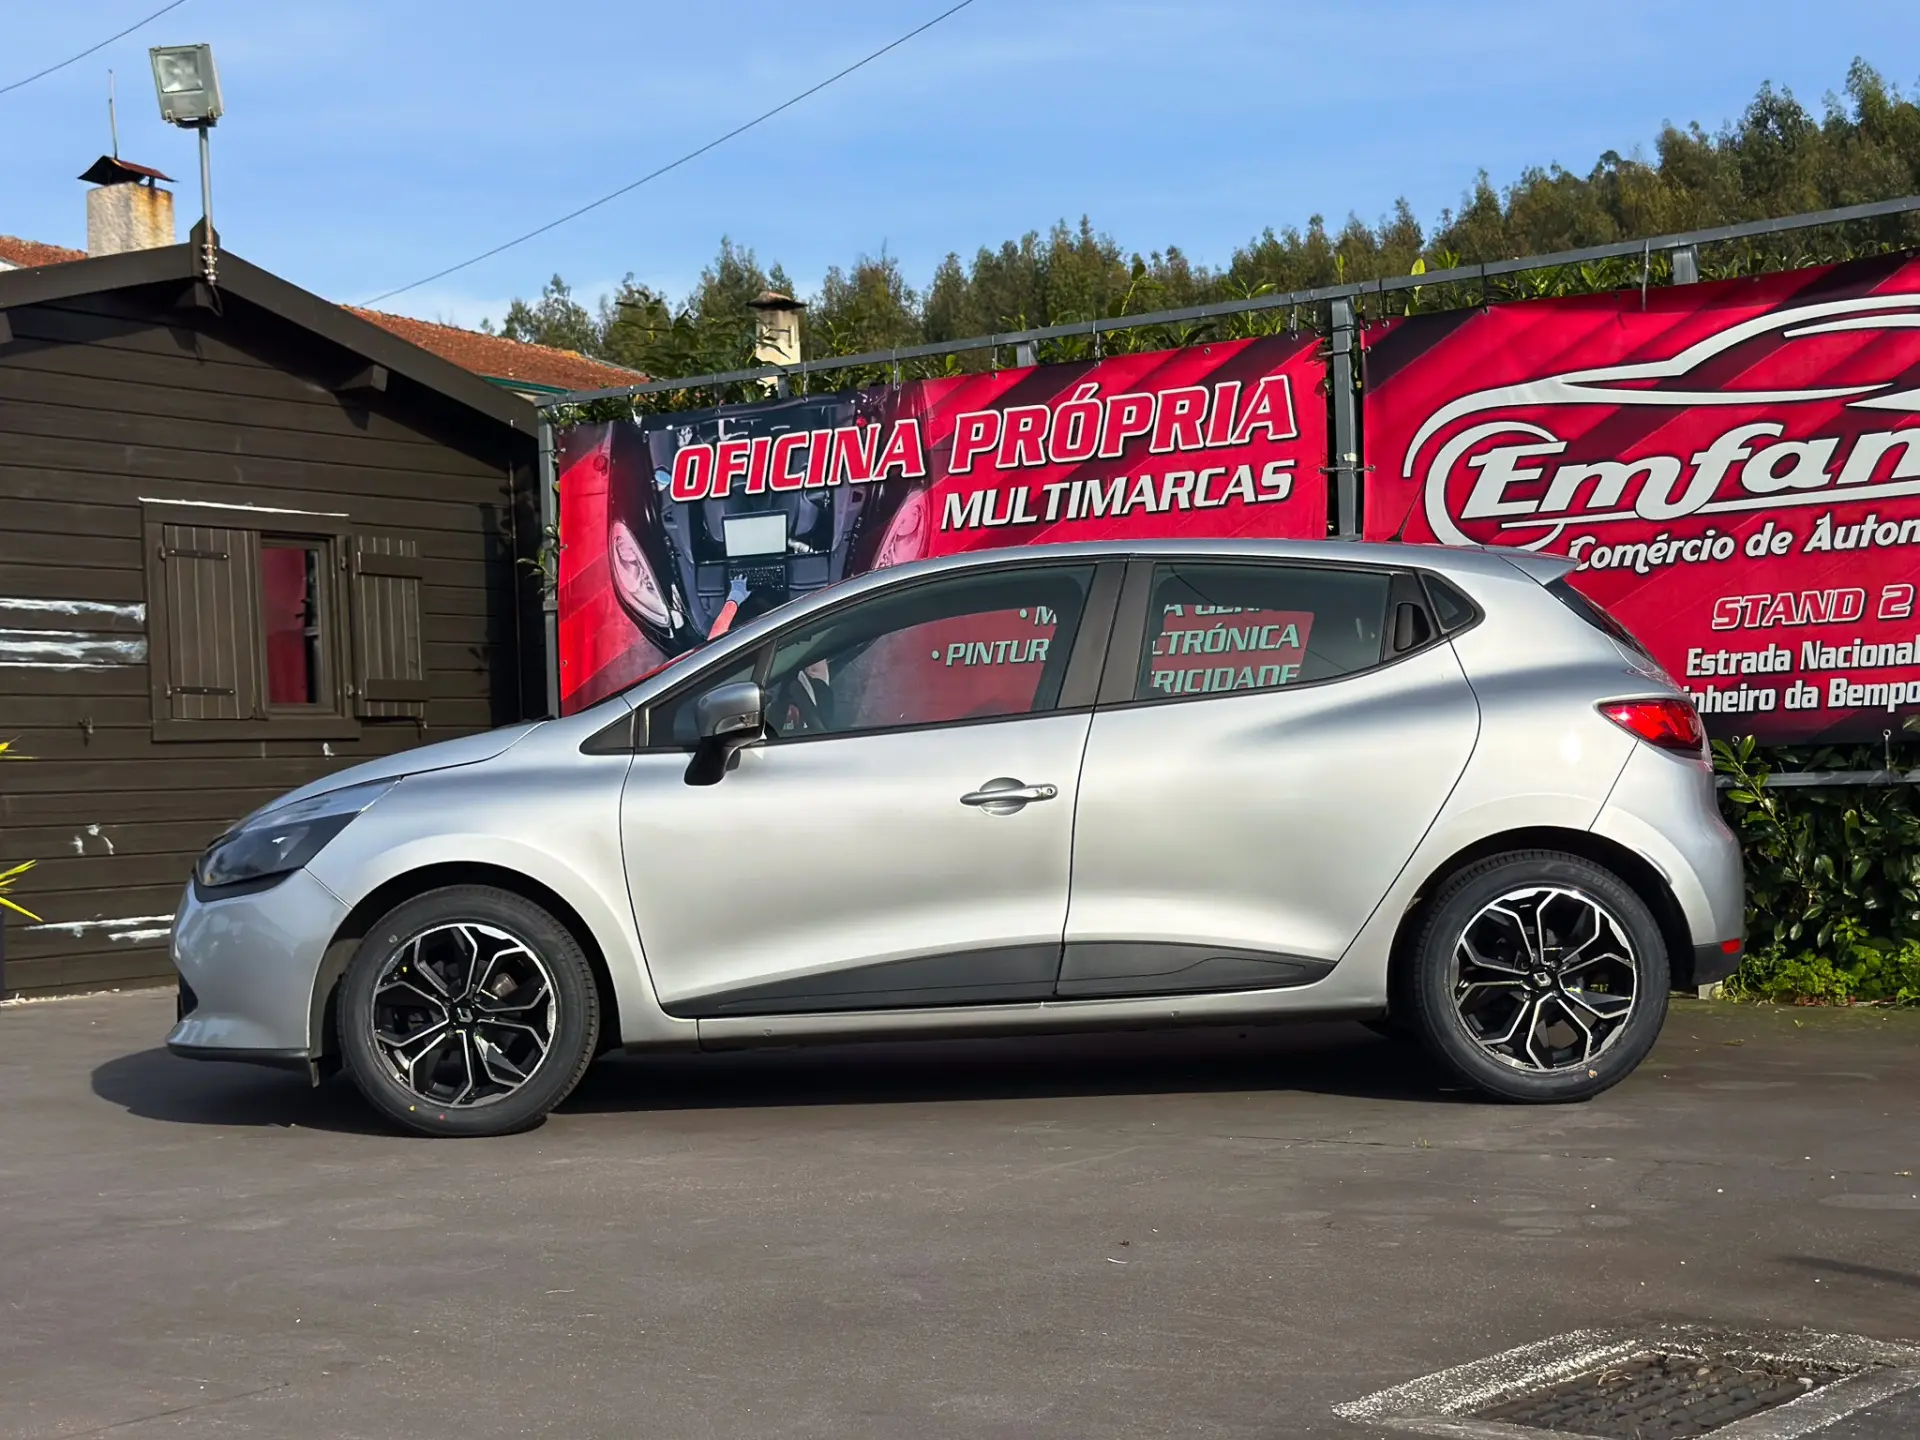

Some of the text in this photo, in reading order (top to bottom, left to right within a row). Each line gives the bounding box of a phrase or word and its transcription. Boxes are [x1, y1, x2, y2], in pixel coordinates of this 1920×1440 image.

[670, 374, 1298, 502] OFICINA PRÓPRIA
[940, 459, 1295, 531] MULTIMARCAS
[1567, 529, 1735, 574] Comércio
[1745, 521, 1794, 555] de
[1711, 583, 1915, 631] STAND 2
[1151, 663, 1300, 694] RICIDADE
[1685, 633, 1920, 677] Estrada Nacional
[1784, 679, 1819, 709] da
[1827, 677, 1920, 713] Bempo
